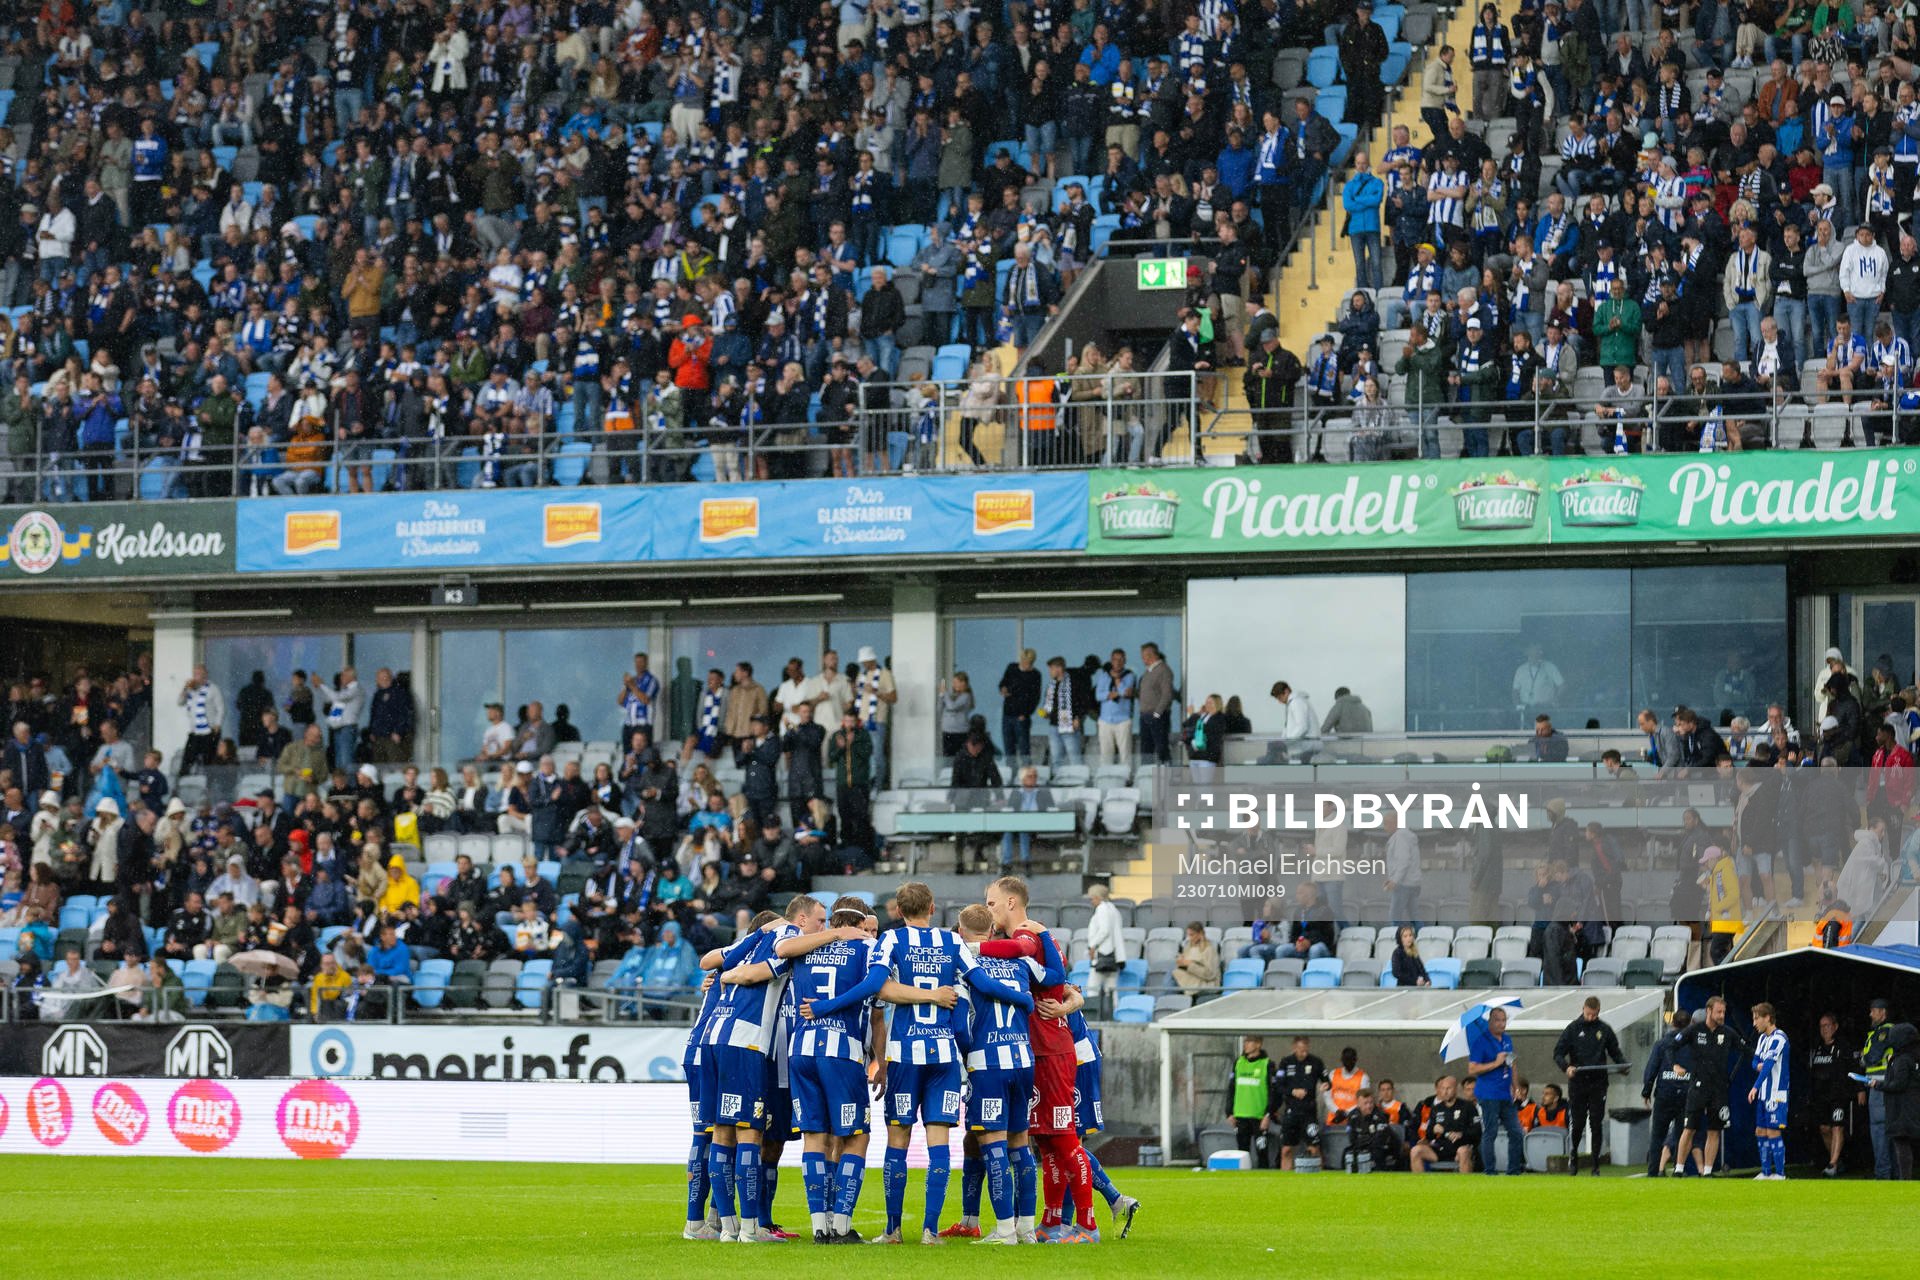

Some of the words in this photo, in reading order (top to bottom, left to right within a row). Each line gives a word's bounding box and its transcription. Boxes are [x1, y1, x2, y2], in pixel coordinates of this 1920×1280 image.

[817, 506, 913, 524] GLASSFABRIKEN
[1101, 501, 1175, 530] Picadeli
[1457, 491, 1536, 521] Picadeli
[1561, 489, 1640, 519] Picadeli
[96, 521, 225, 565] Karlsson
[444, 589, 464, 604] K3
[904, 954, 952, 963] WELLNESS
[909, 947, 944, 955] NORDIC
[912, 962, 942, 974] HAGEN
[917, 1027, 952, 1036] KONTAKT
[50, 1032, 104, 1075] MG
[173, 1032, 228, 1075] MG
[175, 1095, 233, 1127] mix
[286, 1098, 351, 1133] mix
